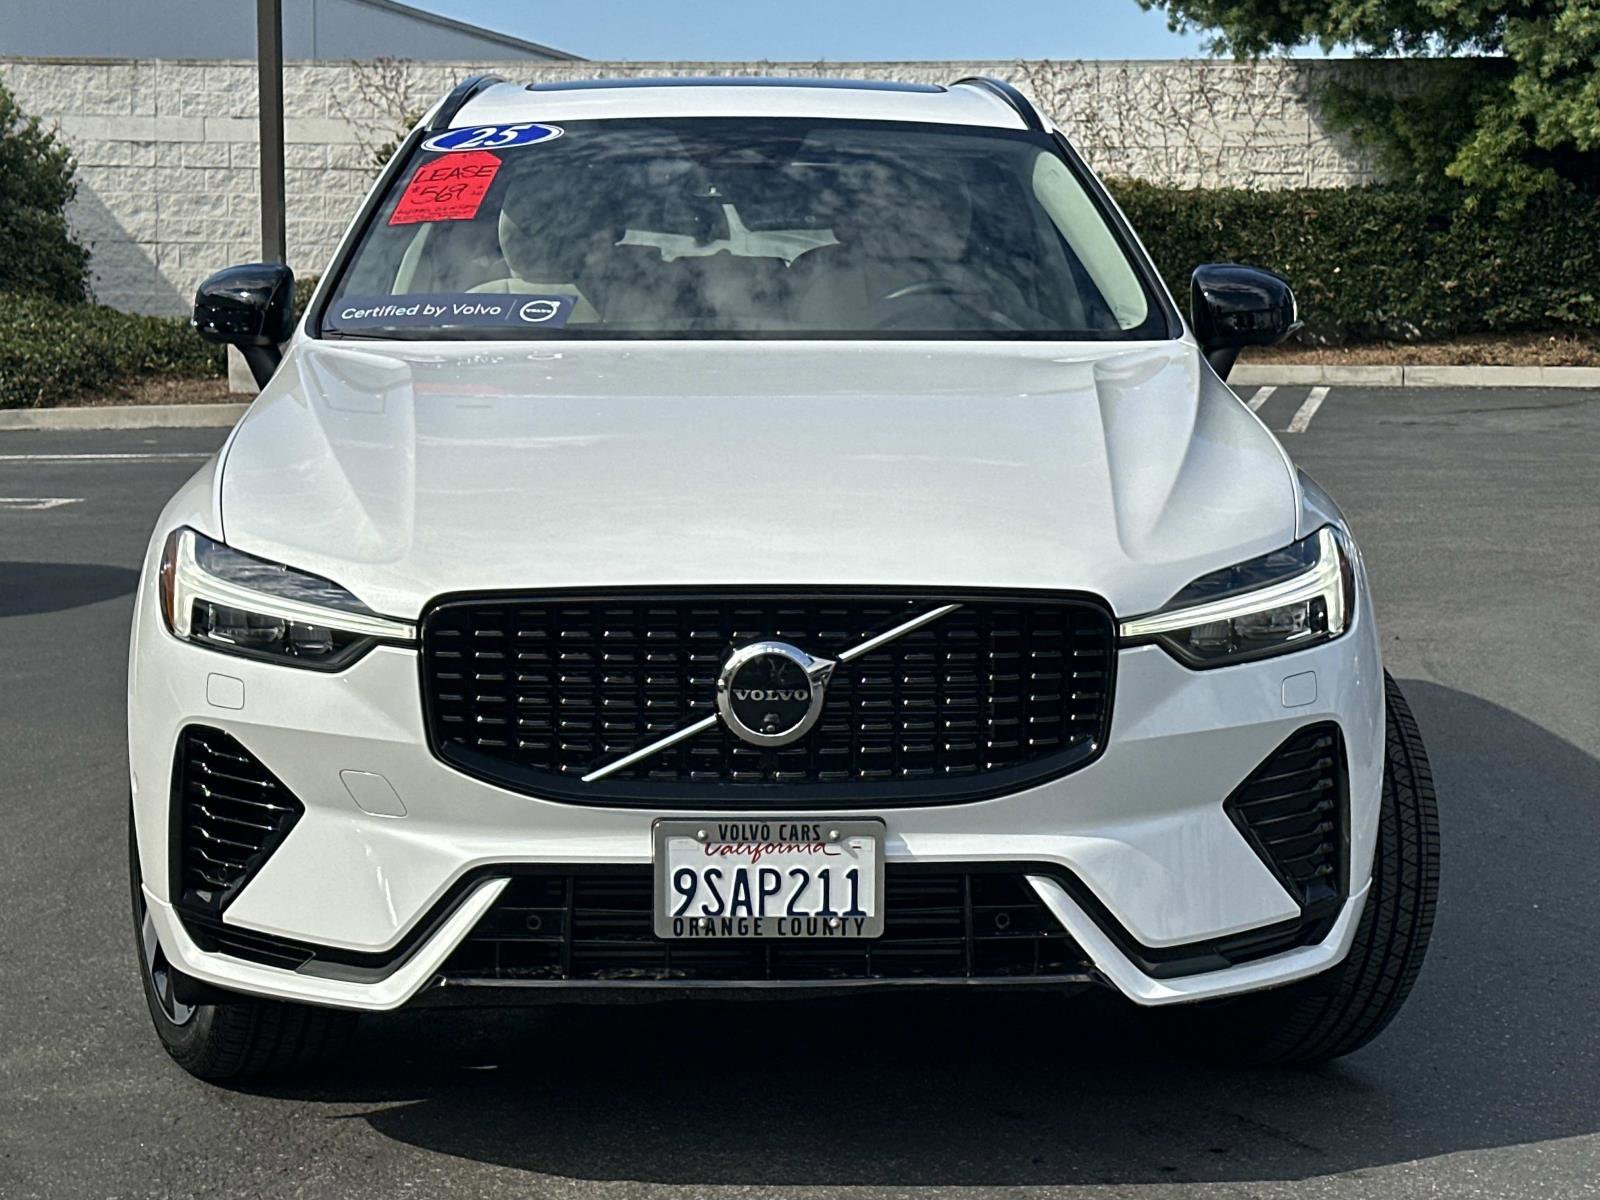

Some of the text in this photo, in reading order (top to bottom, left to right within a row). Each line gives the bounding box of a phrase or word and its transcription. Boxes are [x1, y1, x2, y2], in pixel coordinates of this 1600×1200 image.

[452, 125, 532, 149] 25
[413, 165, 500, 184] LEASE
[341, 303, 501, 320] Certified by Volvo
[732, 689, 808, 701] VOLVO
[718, 824, 821, 841] VOLVO CARS
[704, 842, 841, 864] California
[672, 867, 868, 917] 9SAP211
[673, 918, 865, 936] ORANGE COUNTY
